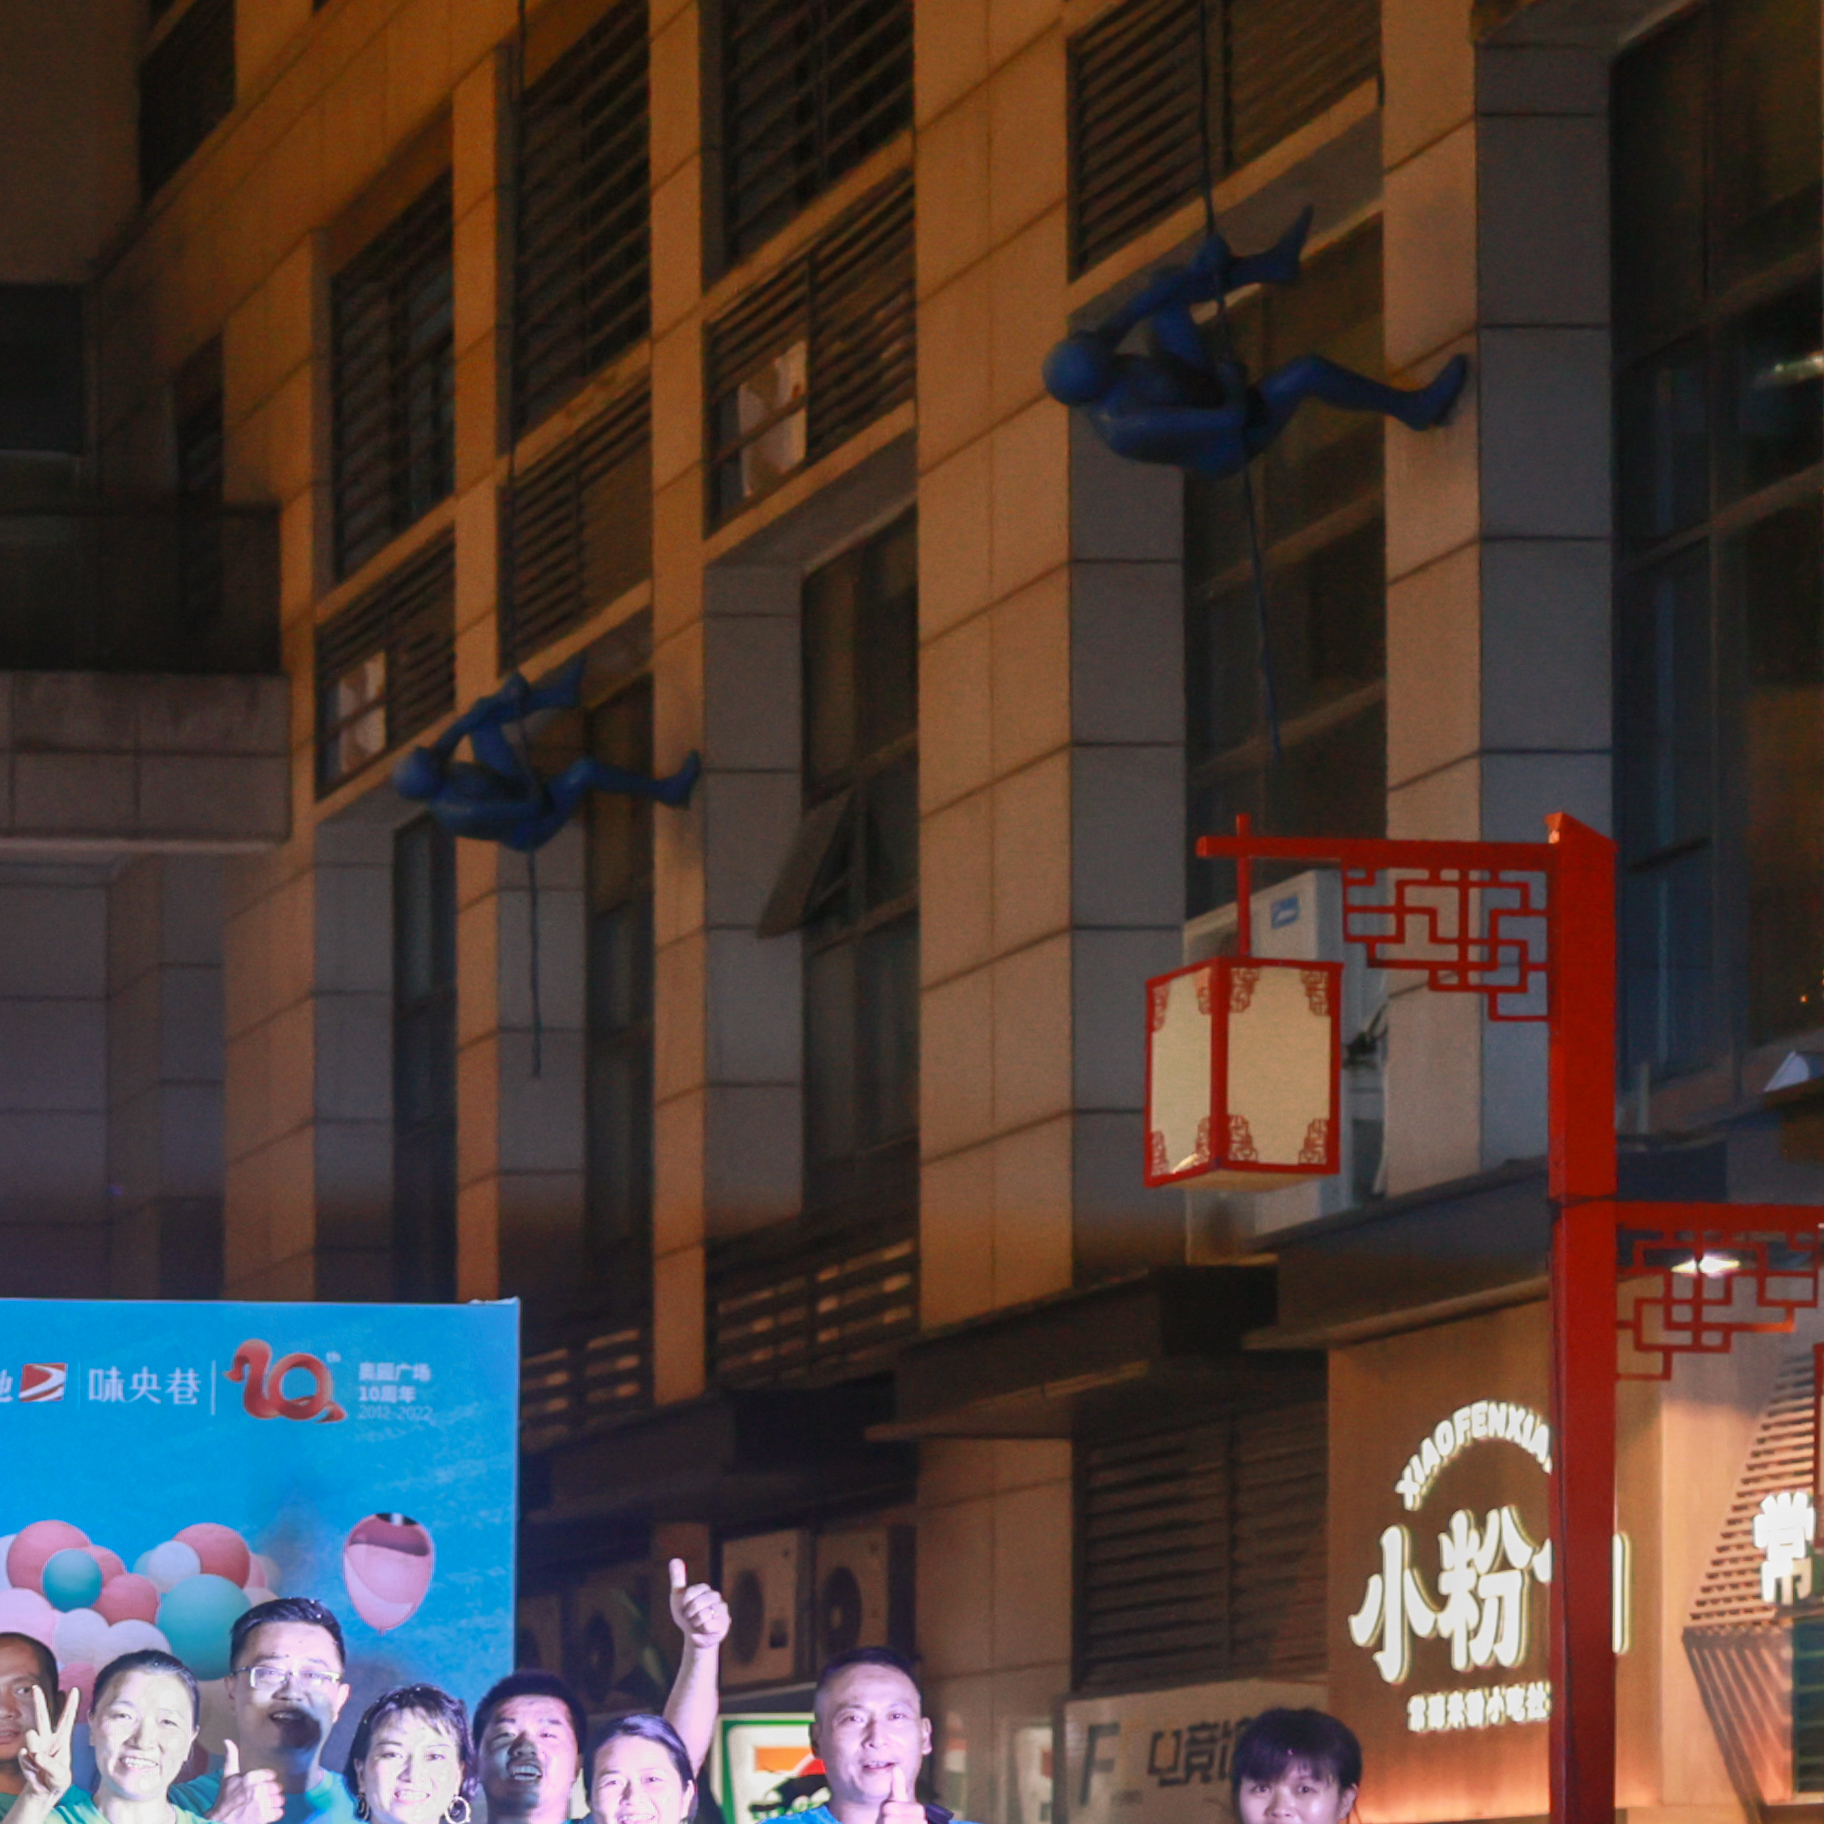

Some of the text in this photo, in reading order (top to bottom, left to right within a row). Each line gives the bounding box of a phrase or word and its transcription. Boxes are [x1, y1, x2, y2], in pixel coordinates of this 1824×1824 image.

[88, 1365, 202, 1406] 味央巷
[1395, 1401, 1552, 1509] XIAOFENXIA
[1349, 1506, 1631, 1684] 小粉
